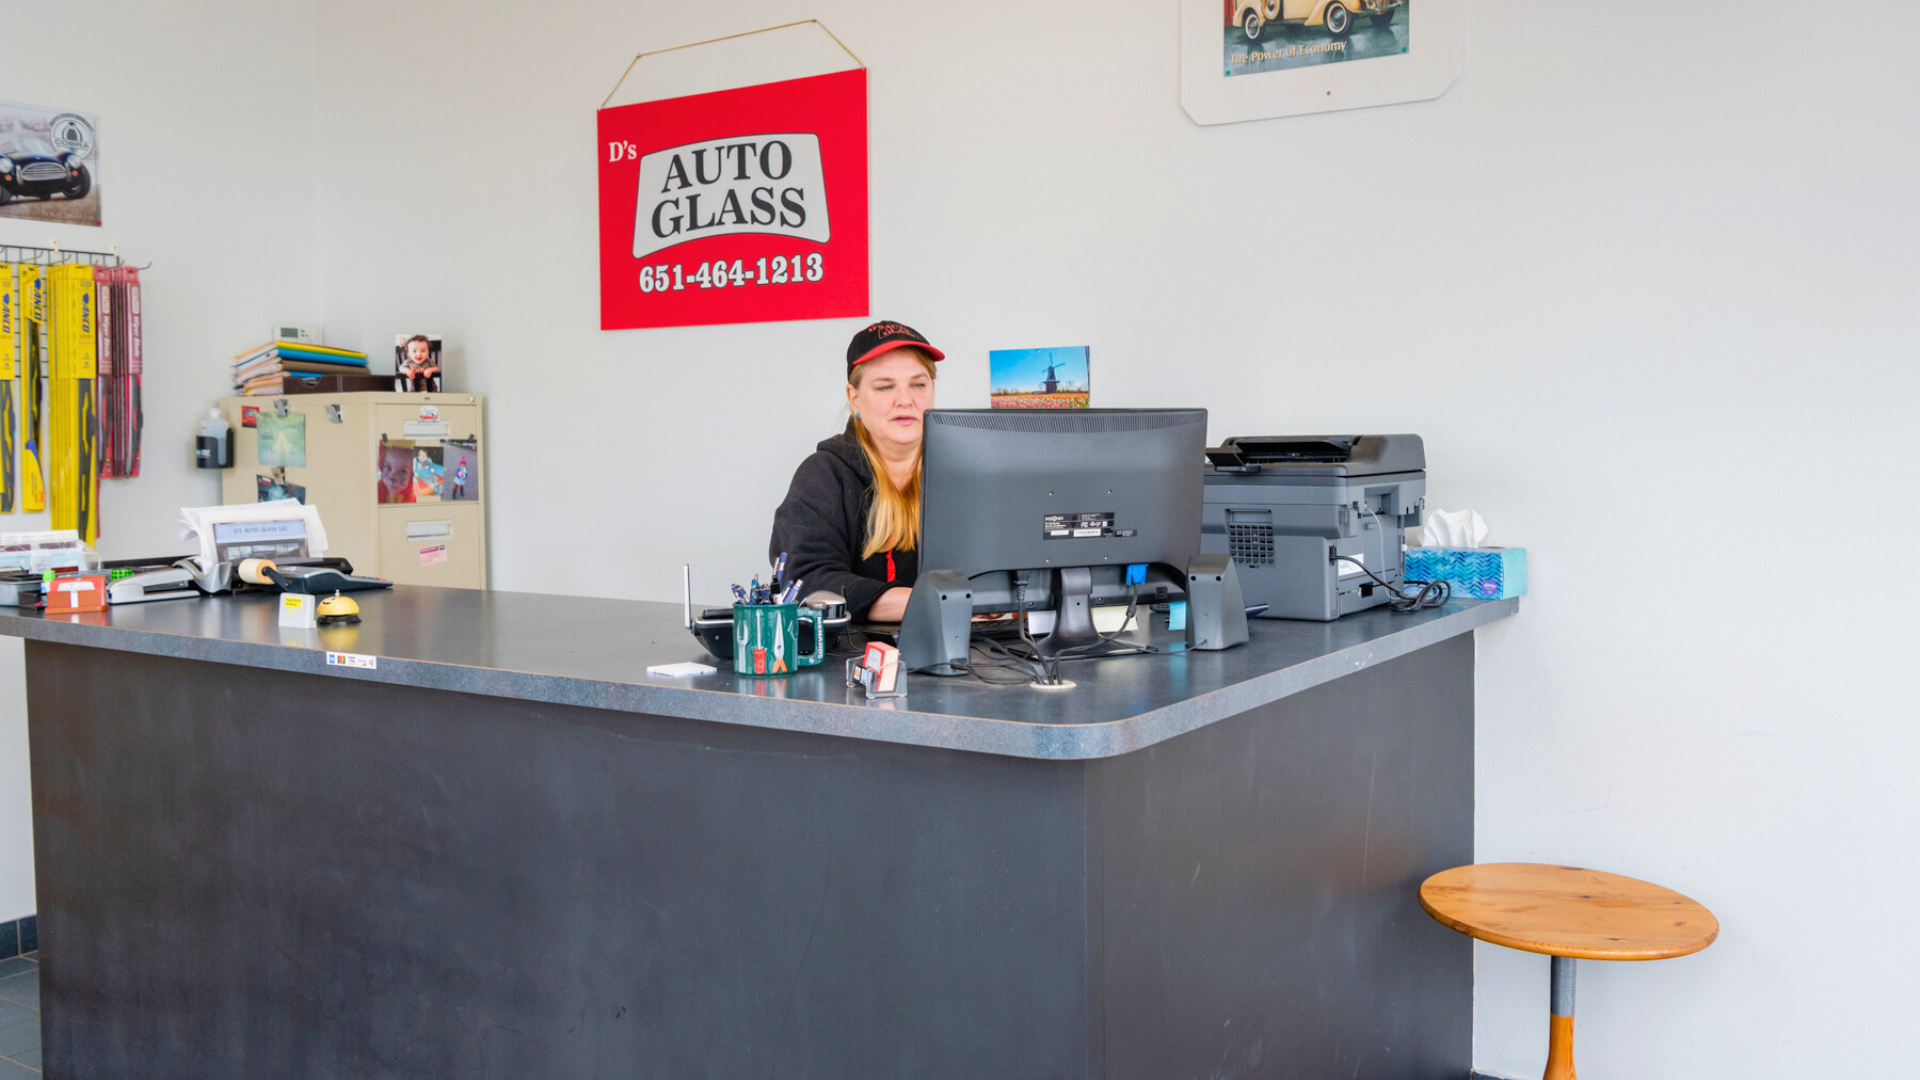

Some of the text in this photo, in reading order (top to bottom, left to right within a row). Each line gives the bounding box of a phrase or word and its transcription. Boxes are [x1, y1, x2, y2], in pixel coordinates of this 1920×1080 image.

[1230, 41, 1347, 65] The Power of Economy
[608, 140, 637, 162] D's
[661, 140, 793, 194] AUTO
[651, 186, 807, 239] GLASS
[639, 252, 824, 294] 651-464-1213
[1, 304, 11, 334] ANCO
[33, 287, 43, 321] ANCO
[82, 304, 91, 333] ANCO
